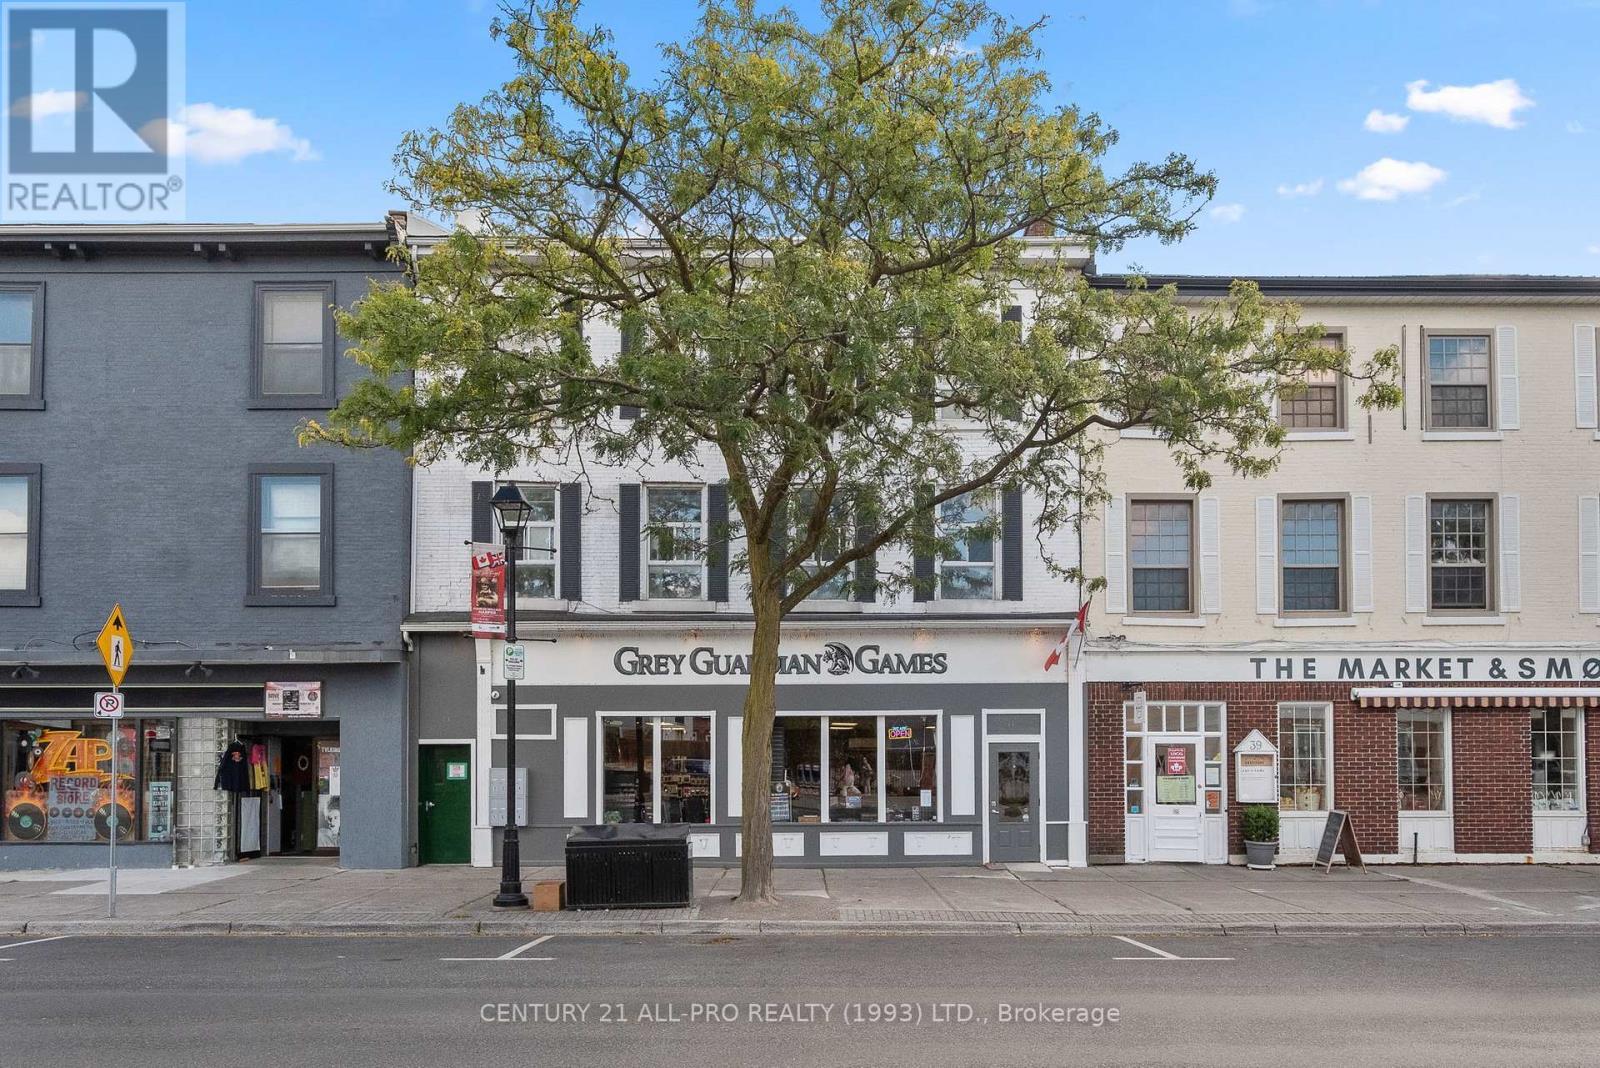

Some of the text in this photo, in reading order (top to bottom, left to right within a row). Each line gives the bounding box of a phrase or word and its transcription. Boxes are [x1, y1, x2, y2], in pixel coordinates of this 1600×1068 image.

[614, 645, 948, 675] GREY GUAIAN GAMES
[1250, 658, 1317, 679] THE
[1338, 658, 1474, 679] MARKET
[51, 777, 98, 791] RECORD
[56, 791, 90, 805] STORE
